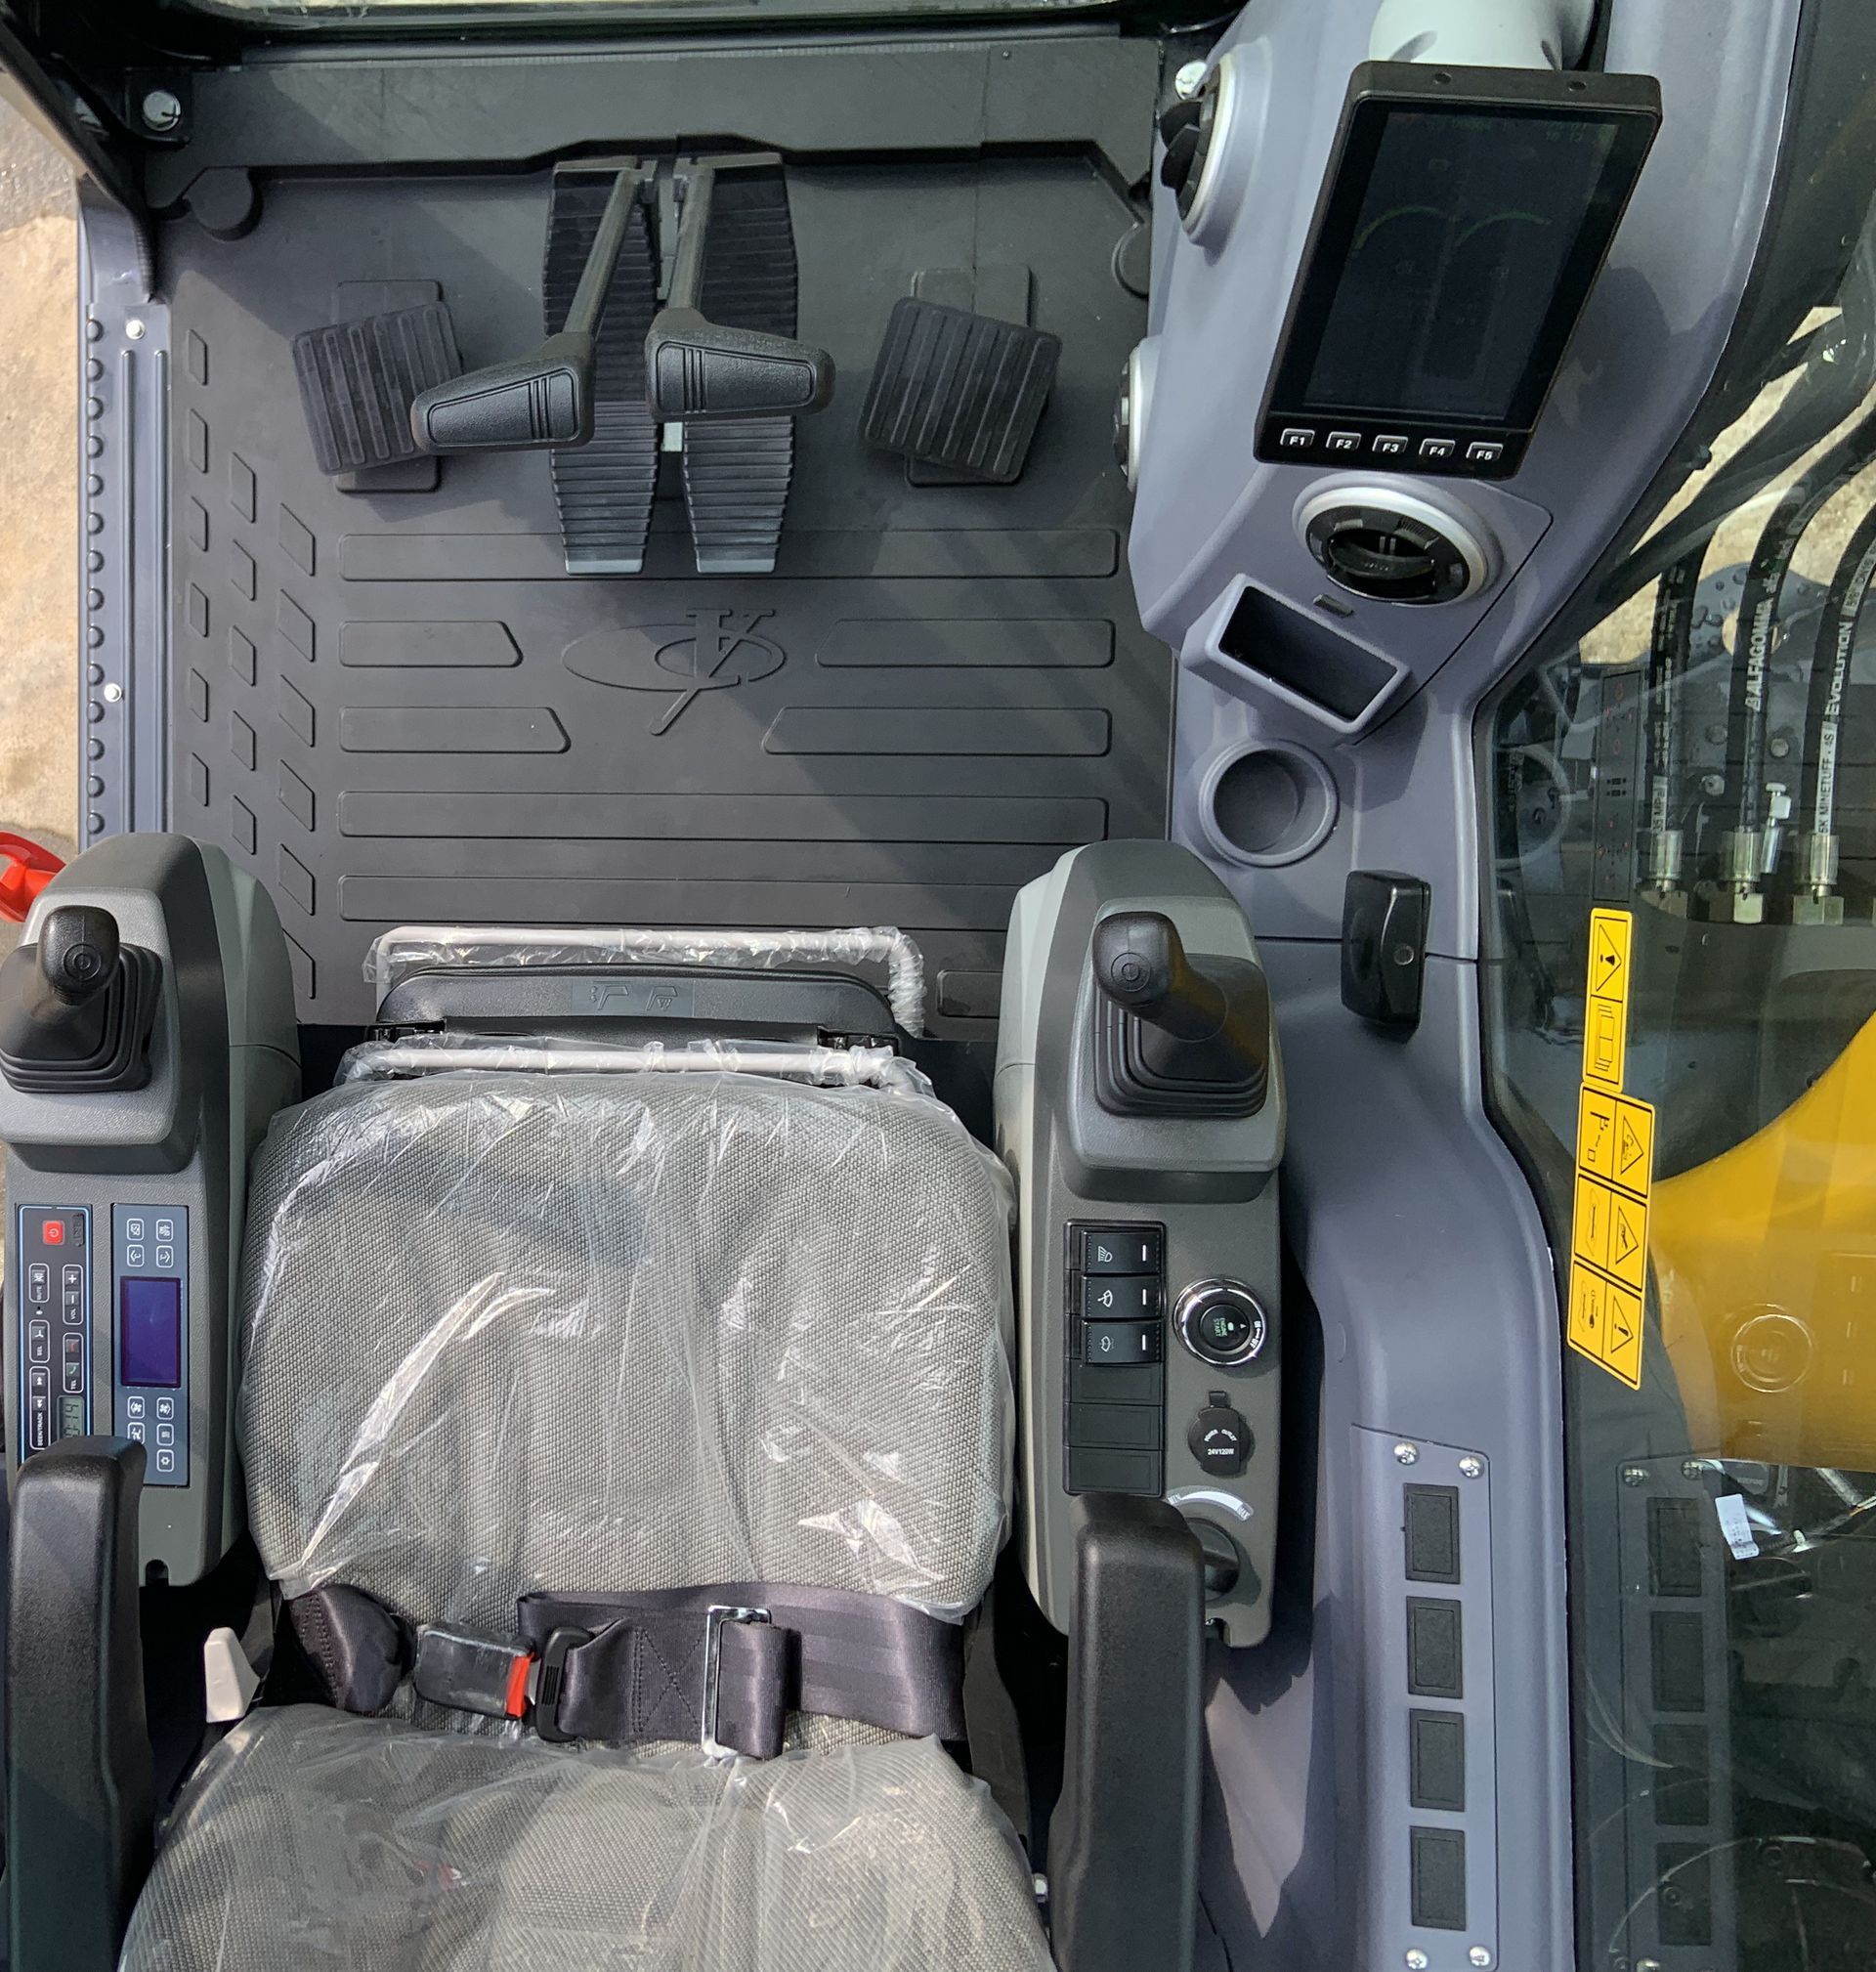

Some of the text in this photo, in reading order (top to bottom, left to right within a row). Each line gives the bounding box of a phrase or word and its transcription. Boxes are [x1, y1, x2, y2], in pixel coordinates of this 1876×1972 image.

[1289, 436, 1494, 460] F1 F2 F3 F4 F5
[1747, 597, 1773, 696] ALFAGOMMA
[1825, 622, 1855, 715] EVOLUTION
[1213, 1318, 1221, 1337] START
[1219, 1317, 1228, 1337] ENGINE
[1250, 1338, 1259, 1349] OFF
[1204, 1429, 1238, 1442] POWER OUTLET
[1207, 1447, 1235, 1456] 24V120W
[1168, 1493, 1181, 1506] MIN
[1236, 1507, 1251, 1521] MAX
